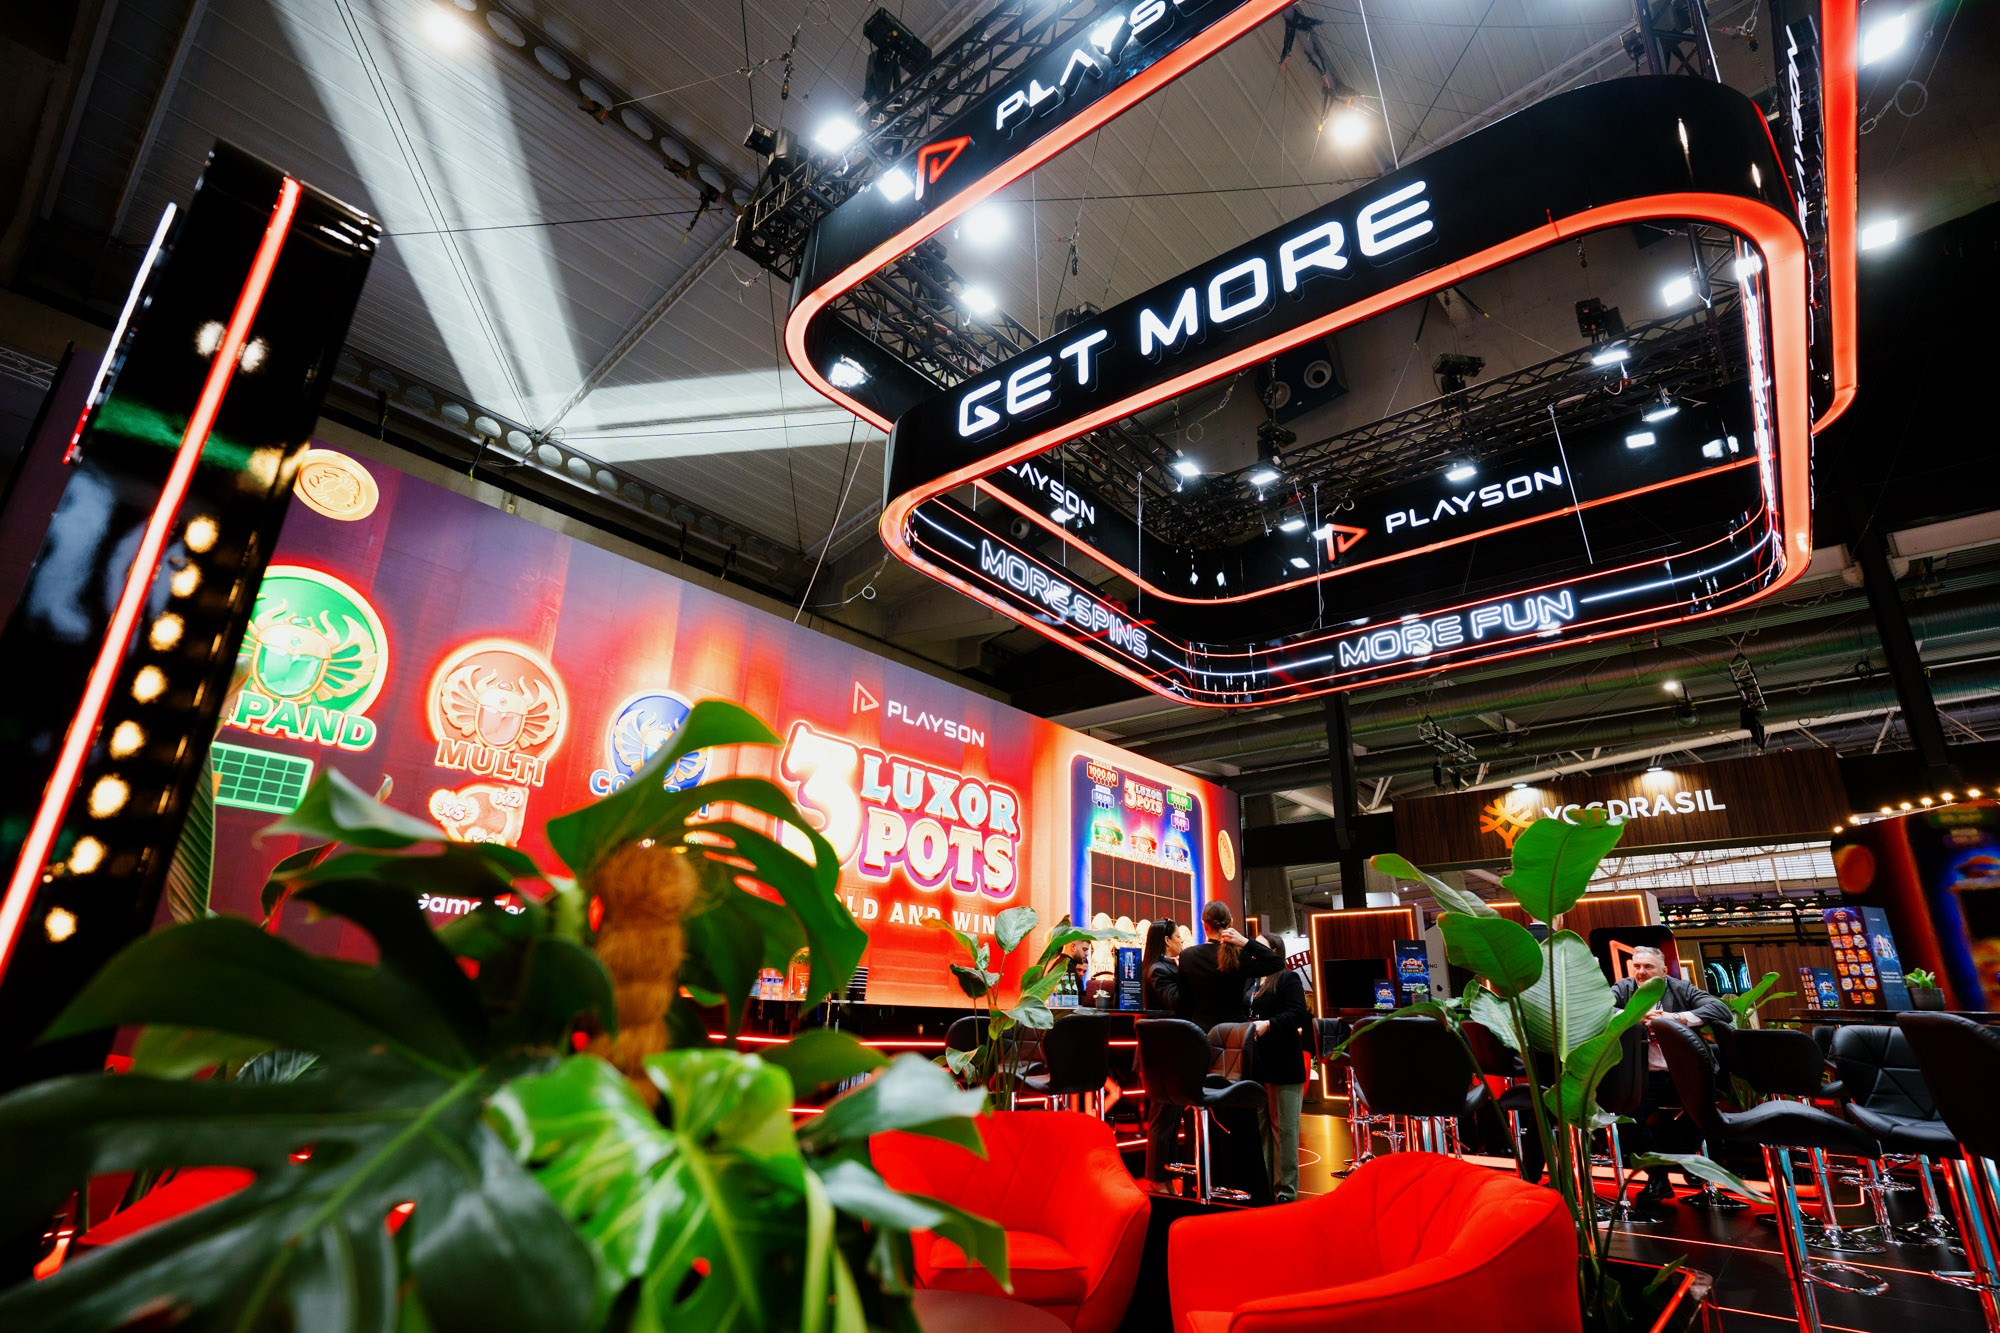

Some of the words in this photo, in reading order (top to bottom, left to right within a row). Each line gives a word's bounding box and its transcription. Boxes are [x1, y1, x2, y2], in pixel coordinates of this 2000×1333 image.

[995, 0, 1187, 131] PLAYS
[958, 329, 1107, 438] GET
[1139, 180, 1434, 356] MORE
[1385, 465, 1563, 534] PLAYSON
[981, 539, 1070, 615] MORE
[1073, 594, 1149, 659] SPINS
[1339, 615, 1464, 667] MORE
[1470, 590, 1574, 639] FUN
[232, 690, 377, 752] PAND
[888, 699, 985, 748] PLAYSON
[434, 736, 547, 788] MULTI
[776, 721, 861, 874] 3
[861, 753, 1019, 837] LUXOR
[861, 806, 1015, 892] POTS
[888, 902, 942, 927] AND
[952, 910, 996, 935] WIN
